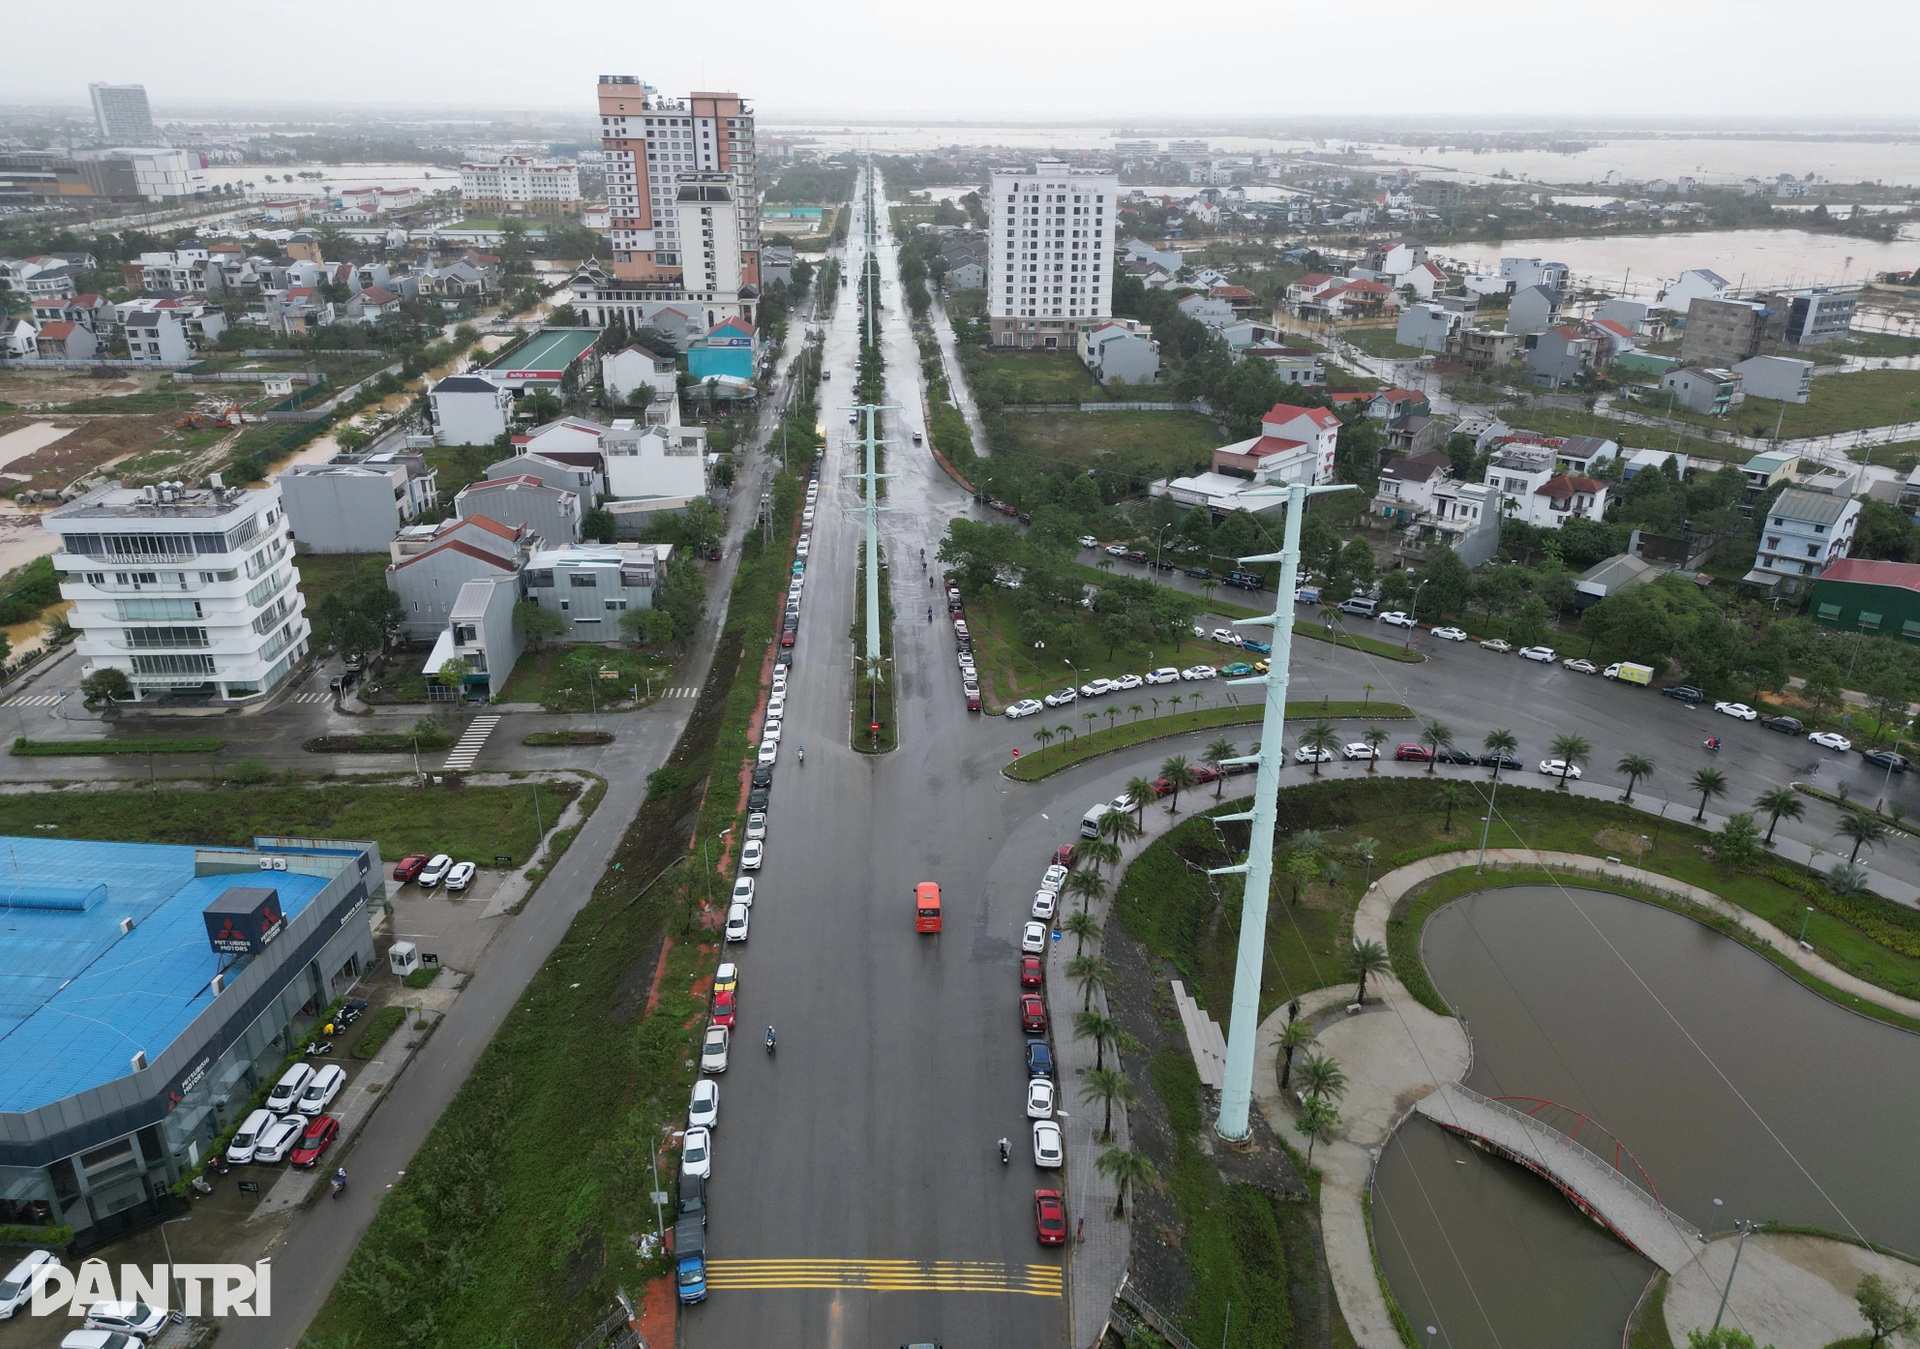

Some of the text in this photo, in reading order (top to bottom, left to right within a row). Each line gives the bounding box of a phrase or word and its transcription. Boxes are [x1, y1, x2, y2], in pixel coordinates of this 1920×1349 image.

[108, 553, 178, 564] MINH LINH
[181, 1056, 210, 1089] MITSUBISHI
[183, 1069, 205, 1095] MOTORS
